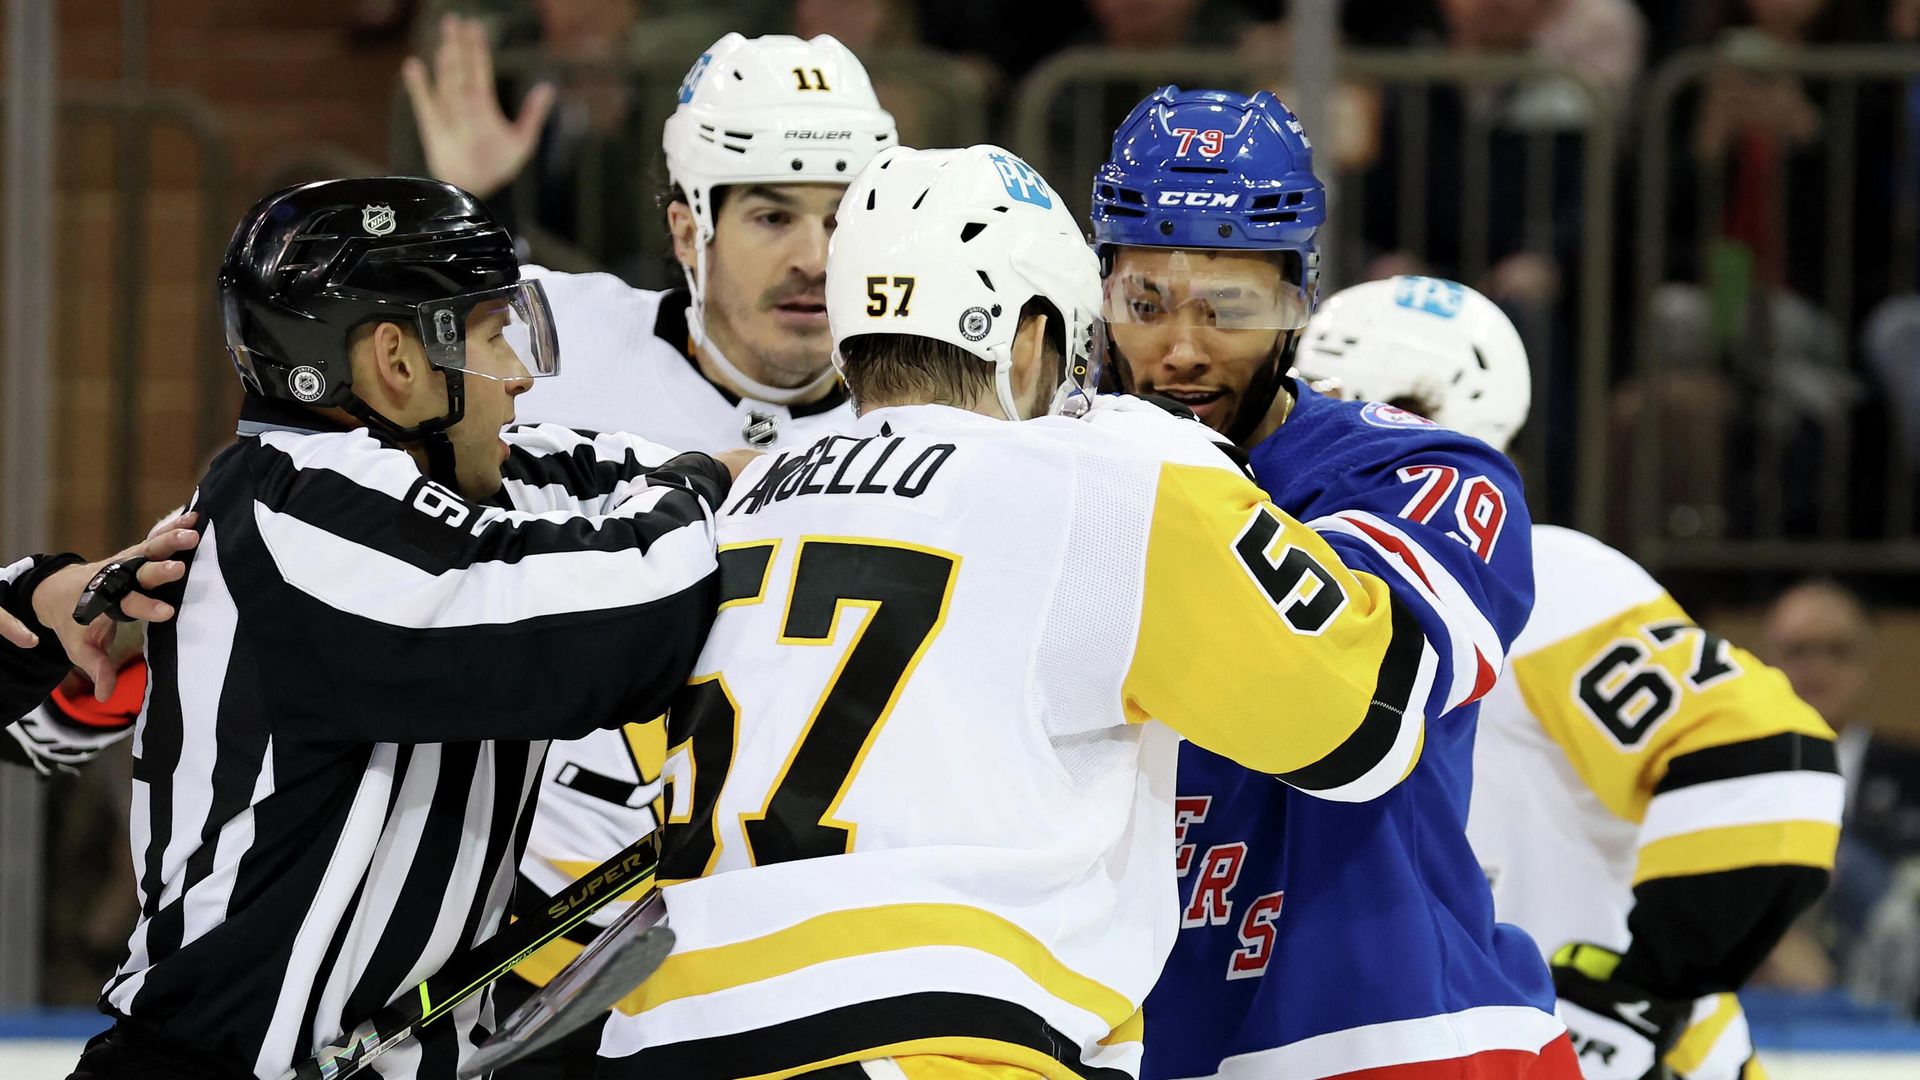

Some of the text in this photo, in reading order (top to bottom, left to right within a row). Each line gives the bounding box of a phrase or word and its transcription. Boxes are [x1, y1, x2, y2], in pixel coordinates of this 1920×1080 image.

[791, 66, 831, 92] 11
[784, 130, 852, 140] BAUER
[1171, 127, 1225, 158] 79
[1157, 190, 1240, 208] CCM
[864, 274, 916, 318] 57
[1396, 464, 1508, 565] 79
[1570, 616, 1744, 754] 67
[655, 534, 964, 887] 57
[547, 852, 643, 919] SUPER
